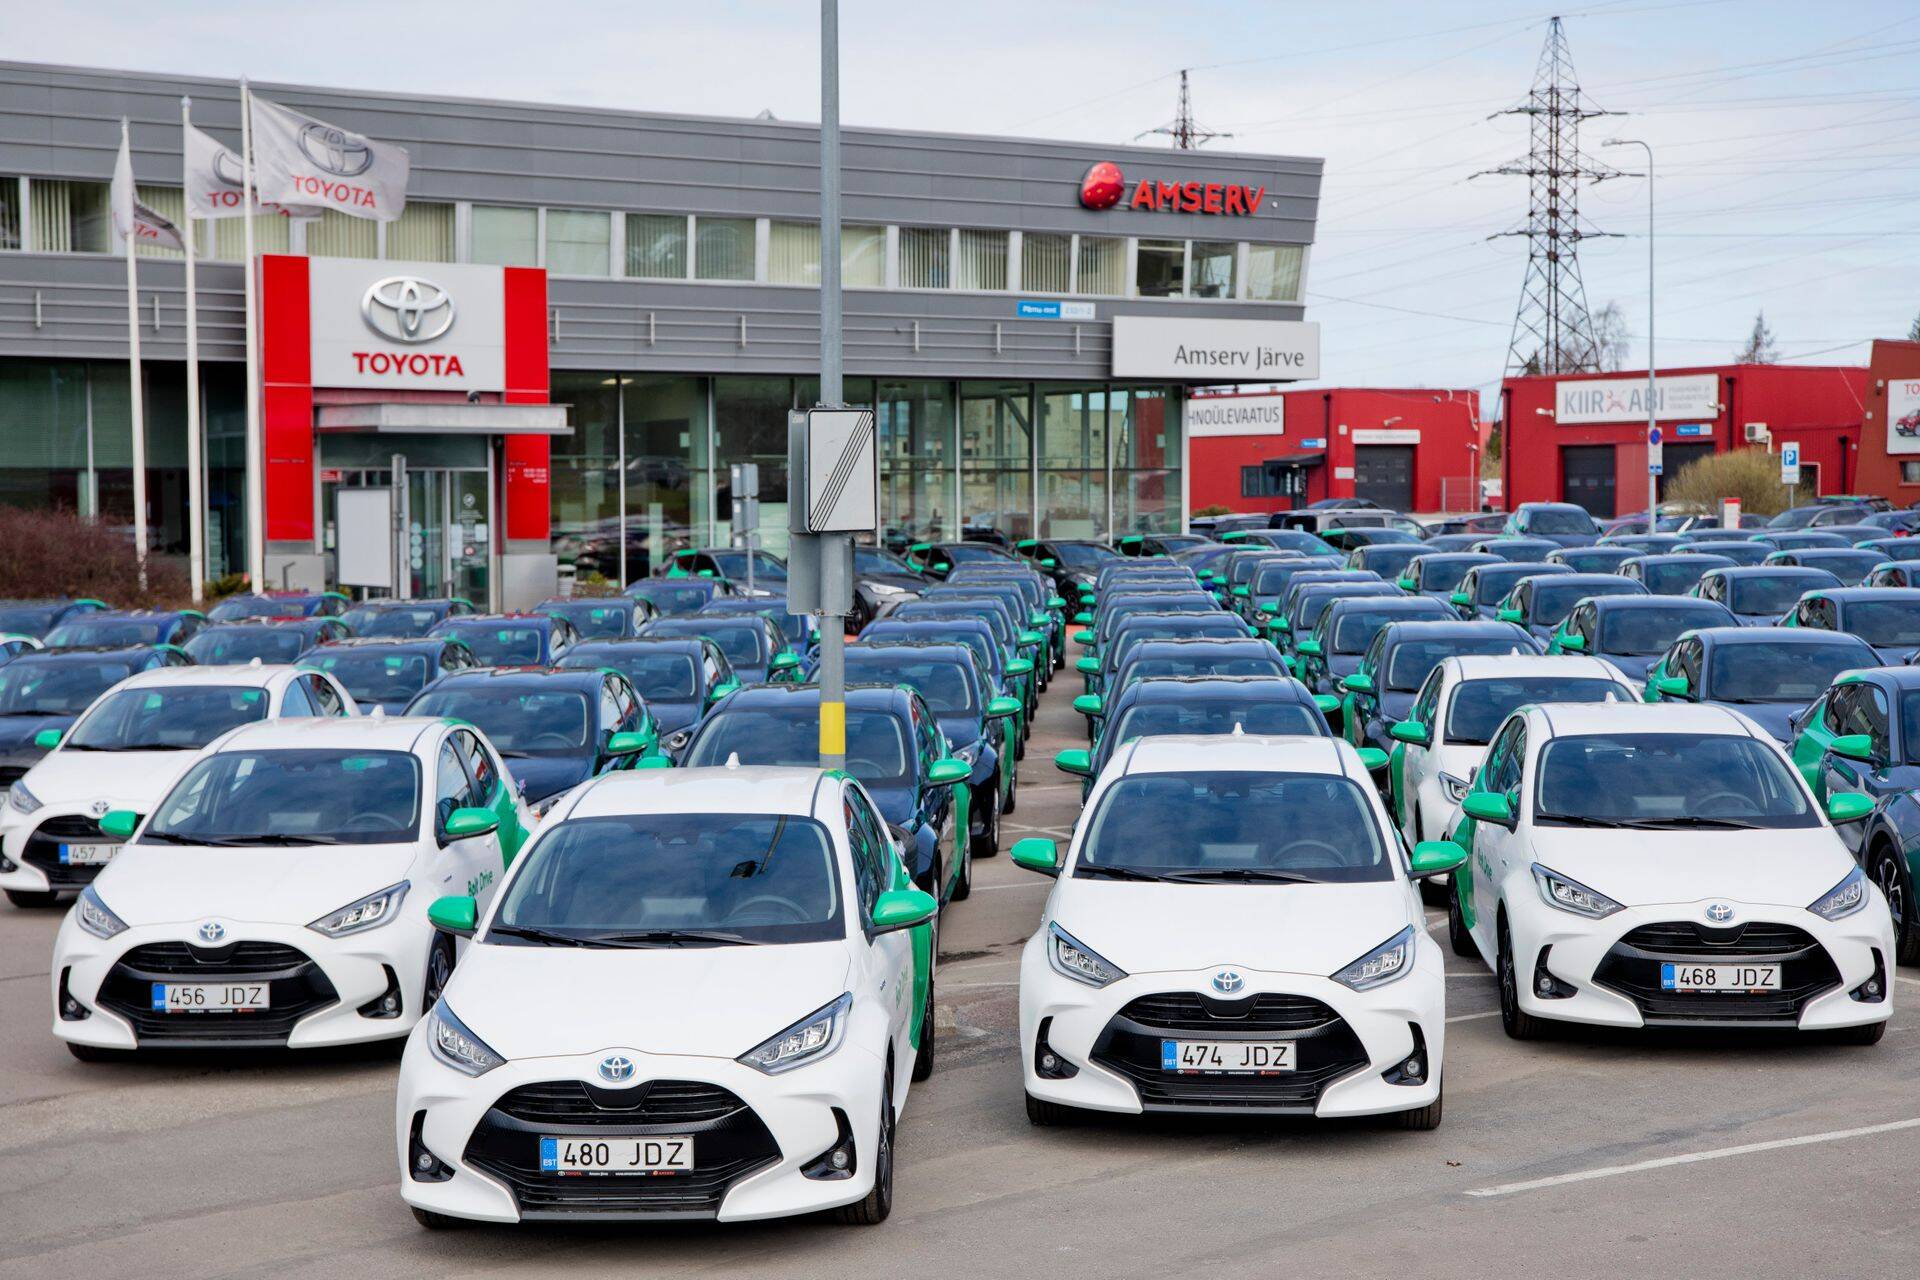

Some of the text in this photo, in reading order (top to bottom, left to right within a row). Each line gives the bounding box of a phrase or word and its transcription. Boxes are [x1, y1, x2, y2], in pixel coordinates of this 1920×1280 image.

[291, 175, 376, 208] TOYOTA
[1131, 178, 1265, 215] AMSERV
[353, 352, 464, 376] TOYOTA
[1174, 344, 1305, 371] Amserv Järve
[1564, 389, 1604, 415] KIIR
[1628, 387, 1664, 413] ABI
[1904, 383, 1920, 396] TO
[72, 846, 96, 860] 457
[1680, 967, 1717, 986] 468
[1732, 968, 1774, 986] JDZ
[170, 987, 205, 1005] 456
[220, 987, 263, 1005] JDZ
[1182, 1045, 1223, 1066] 474
[1240, 1046, 1288, 1067] JDZ
[543, 1142, 684, 1167] EST 480 JDZ
